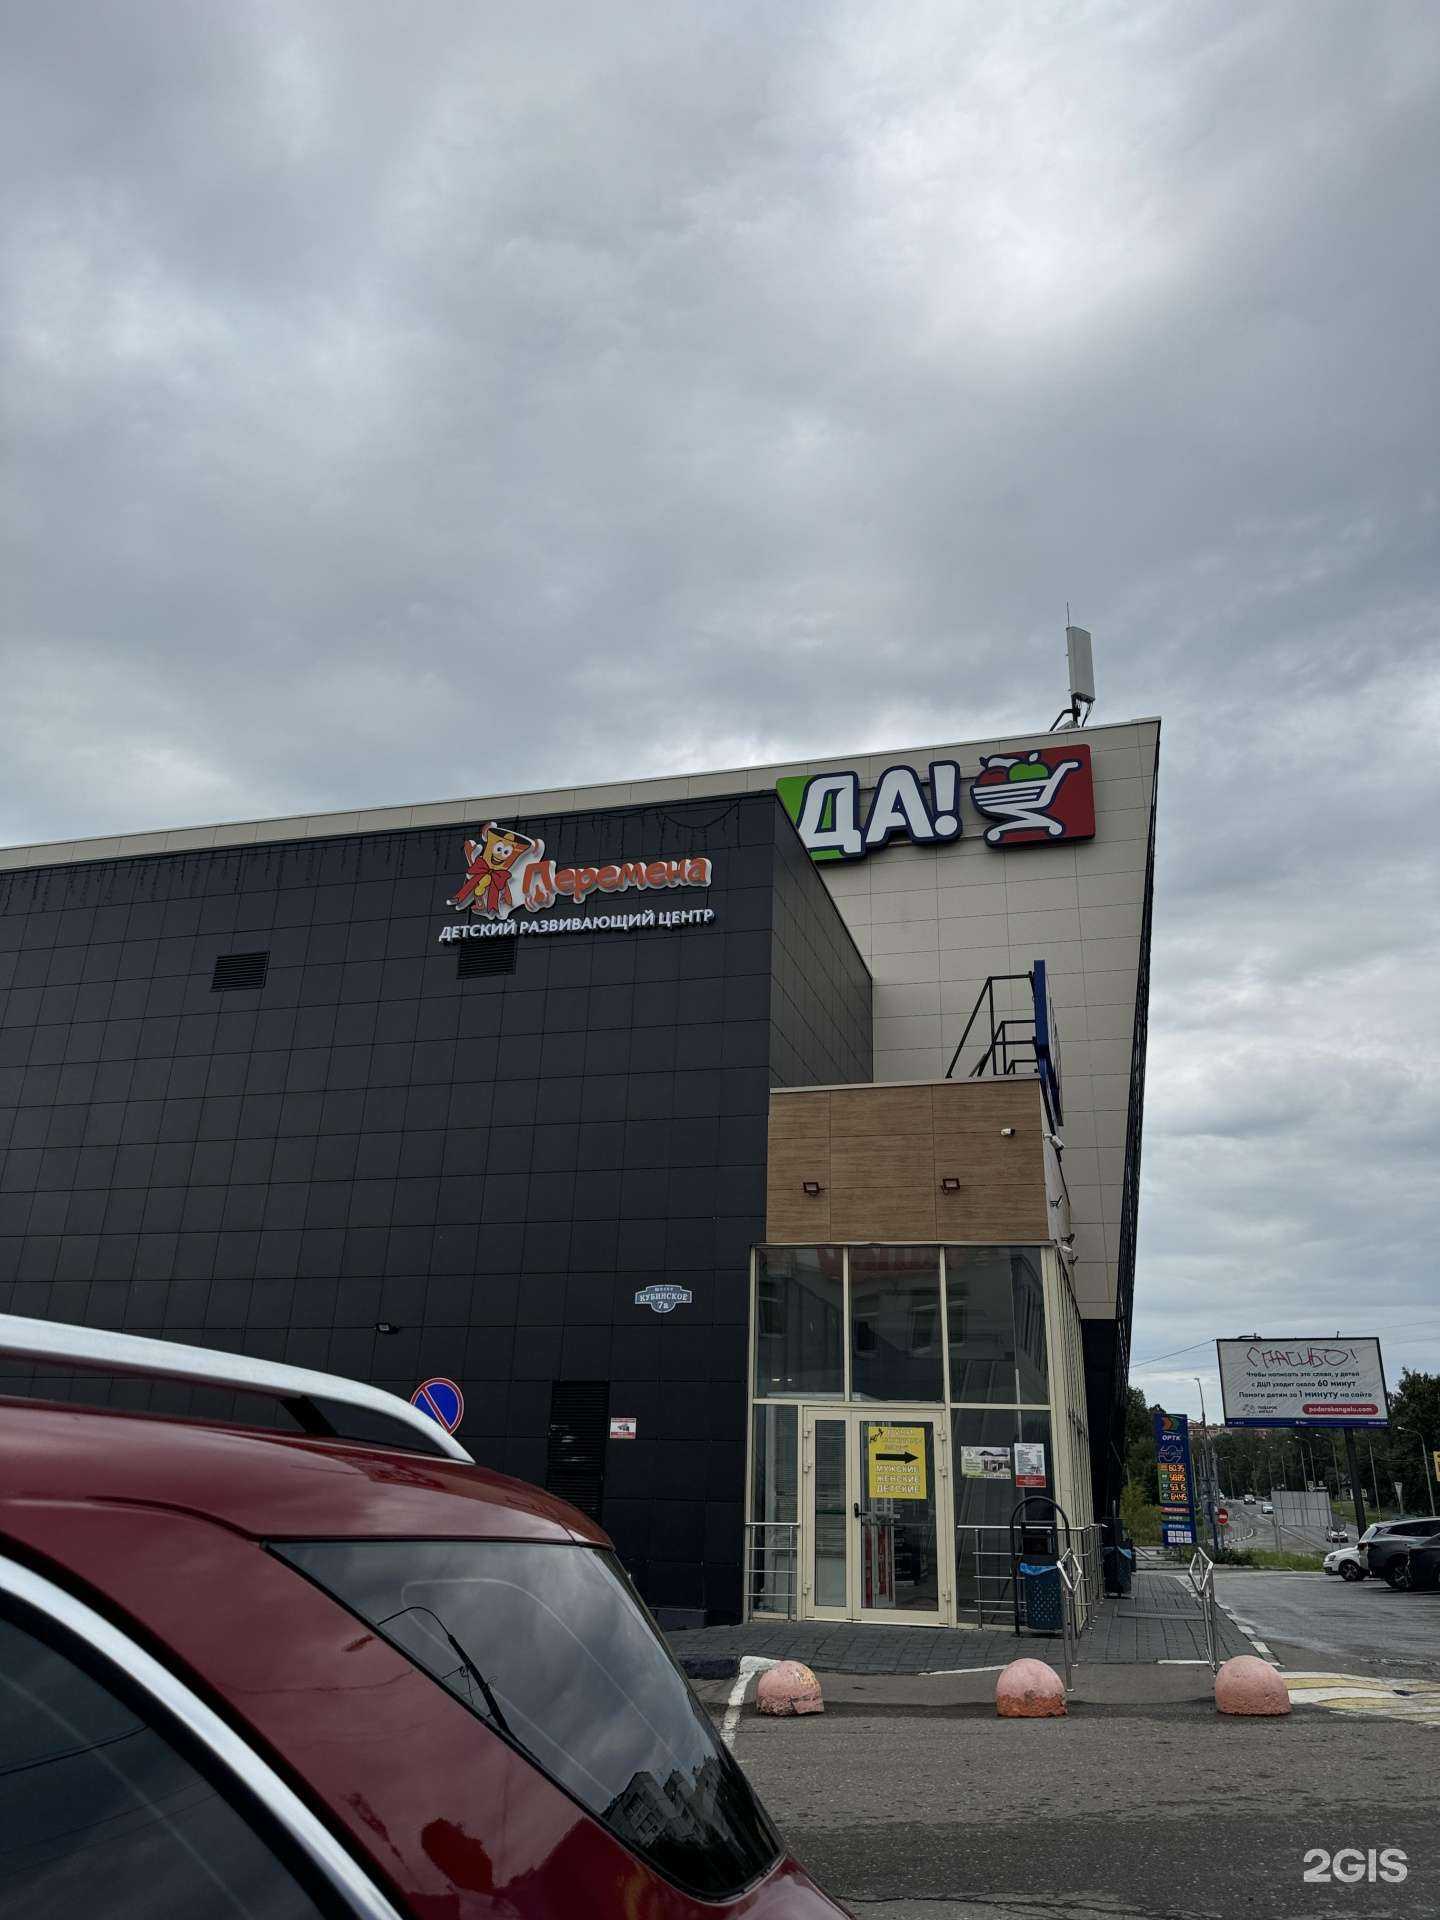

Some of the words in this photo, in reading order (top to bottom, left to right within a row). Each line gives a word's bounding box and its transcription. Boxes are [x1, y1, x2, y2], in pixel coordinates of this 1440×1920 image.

[798, 761, 961, 857] ДА!
[521, 857, 711, 910] Перемена
[439, 918, 517, 942] ДЕТСКИЙ
[520, 910, 655, 934] РАЗВИВАЮЩИЙ
[658, 909, 714, 927] ЦЕНТР
[639, 1292, 689, 1301] КУБИНСКОЕ
[1305, 1391, 1338, 1399] минуту
[876, 1464, 919, 1473] МУЖСКИЕ
